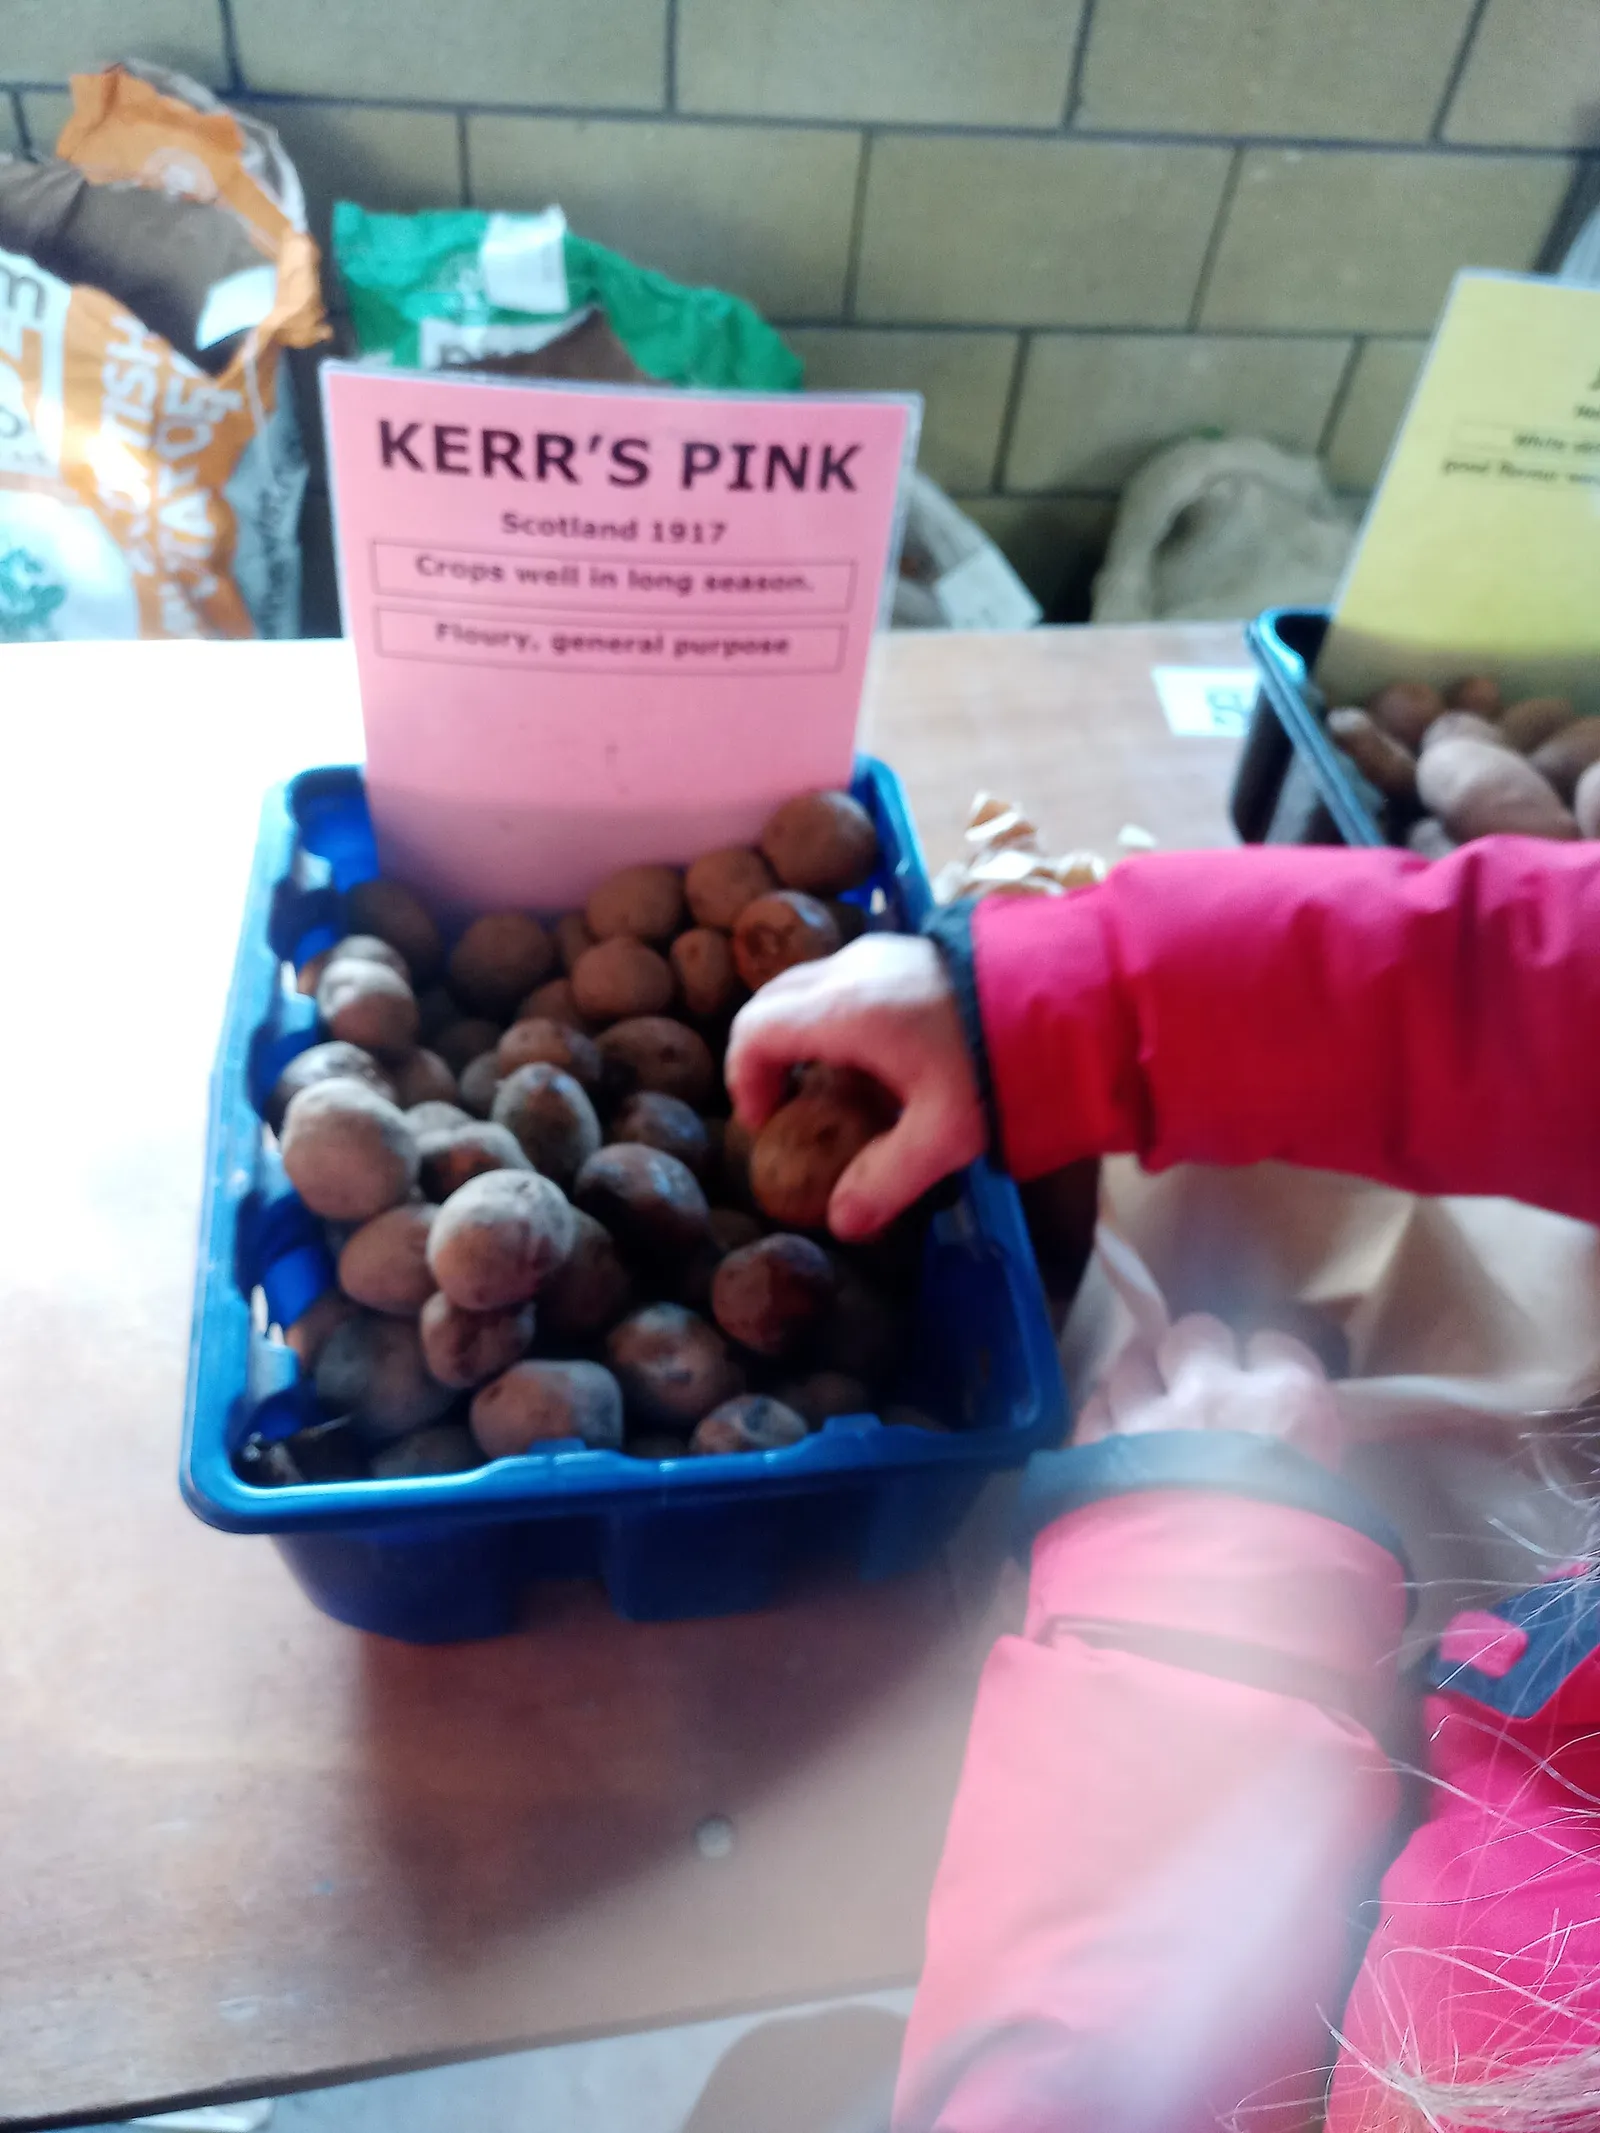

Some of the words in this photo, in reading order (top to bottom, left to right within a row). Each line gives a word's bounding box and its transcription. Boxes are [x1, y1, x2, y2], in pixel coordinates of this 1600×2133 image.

[378, 418, 650, 488] KERR'S
[681, 440, 861, 491] PINK
[501, 511, 638, 542] Scotland
[652, 519, 728, 544] 1917
[415, 553, 504, 584] Crops
[515, 564, 580, 588] well
[589, 565, 618, 588] in
[628, 568, 693, 597] long
[551, 630, 664, 656] general
[673, 638, 789, 660] purpose
